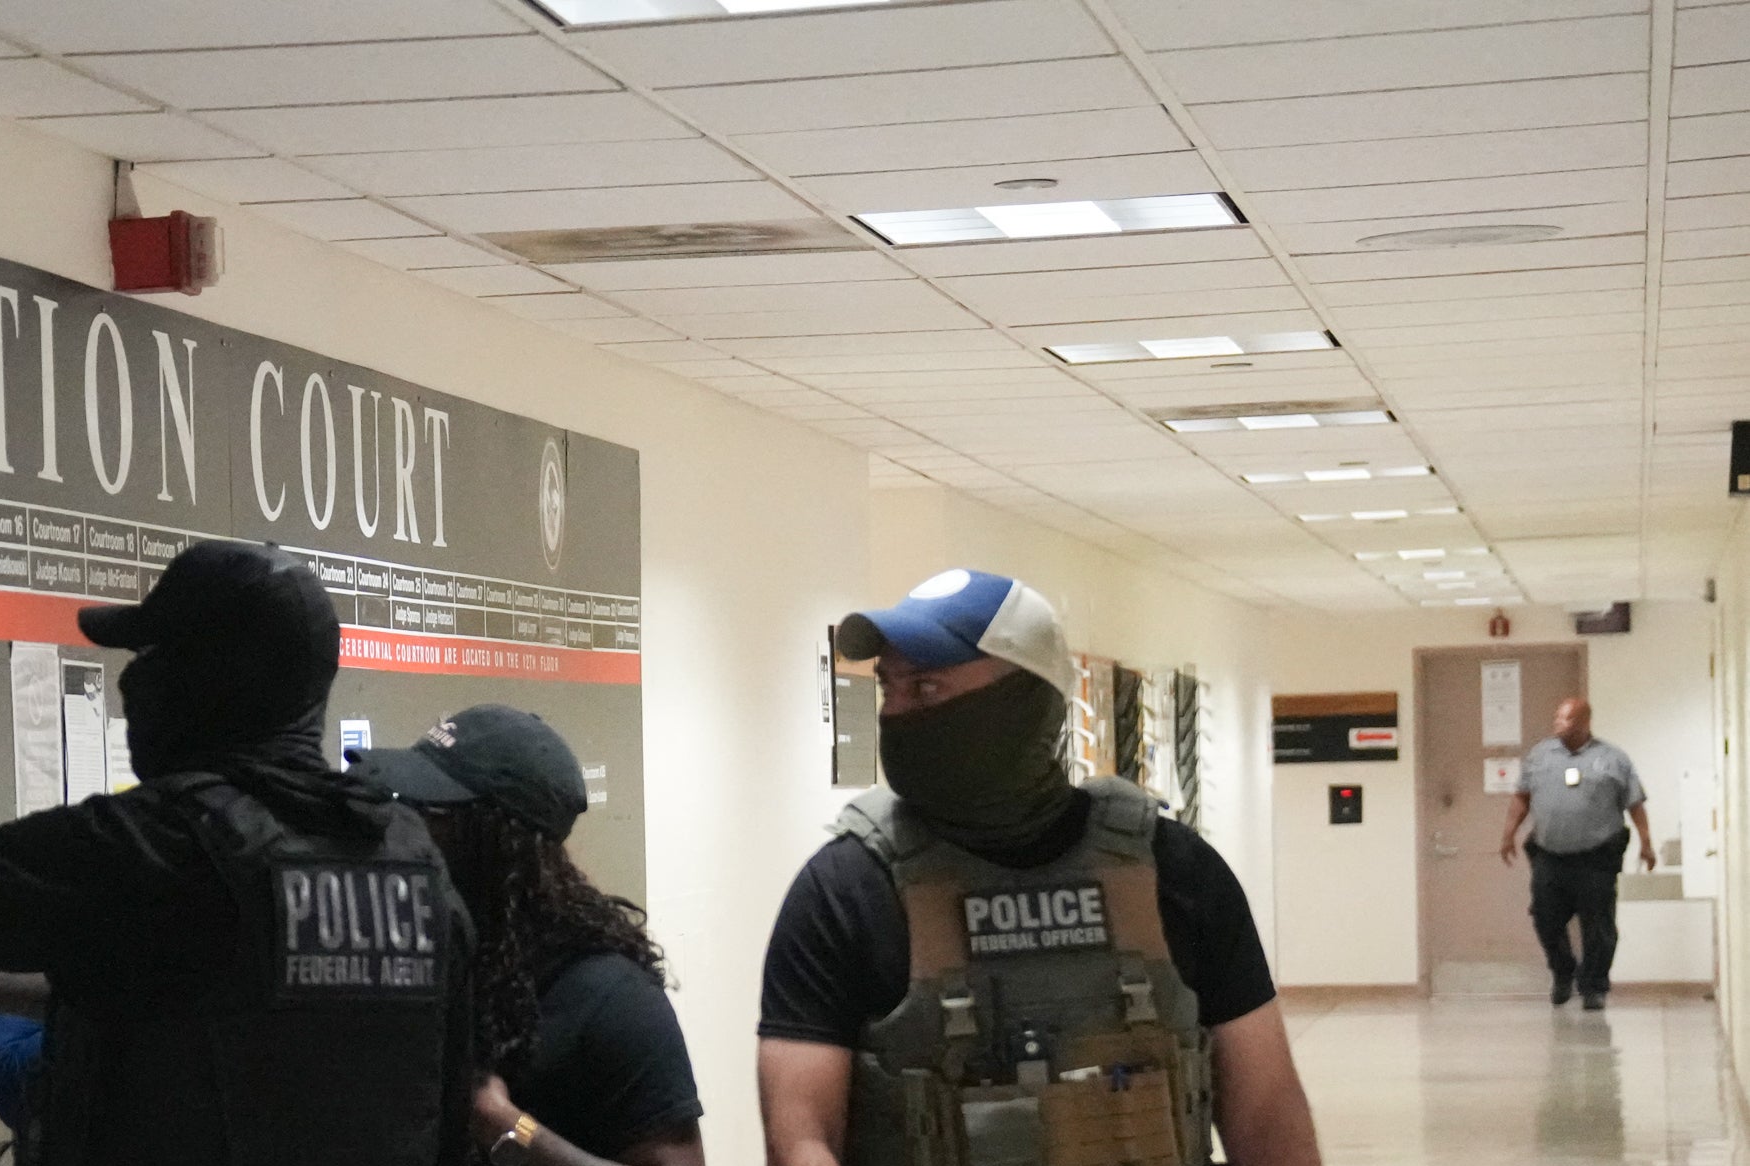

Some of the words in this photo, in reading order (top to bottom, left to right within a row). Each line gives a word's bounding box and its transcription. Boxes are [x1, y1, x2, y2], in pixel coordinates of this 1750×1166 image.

[249, 360, 449, 548] COURT
[15, 515, 23, 536] 16
[33, 518, 70, 544] Courtroom
[73, 524, 81, 545] 17
[89, 526, 125, 551] Courtroom
[126, 533, 134, 553] 18
[142, 535, 176, 558] Courtroom
[36, 558, 57, 585] Judge
[320, 563, 346, 583] Courtroom
[358, 568, 382, 588] Courtroom
[339, 637, 392, 661] CEREMONIAL
[396, 646, 440, 664] COURTROOM
[444, 647, 457, 664] ARE
[462, 649, 490, 666] LOCATED
[494, 651, 503, 668] ON
[507, 653, 518, 669] THE
[283, 870, 435, 953] POLICE
[964, 887, 1103, 932] POLICE
[970, 932, 1038, 952] FEDERAL
[1040, 927, 1107, 947] OFFICER
[286, 955, 372, 986] FEDERAL
